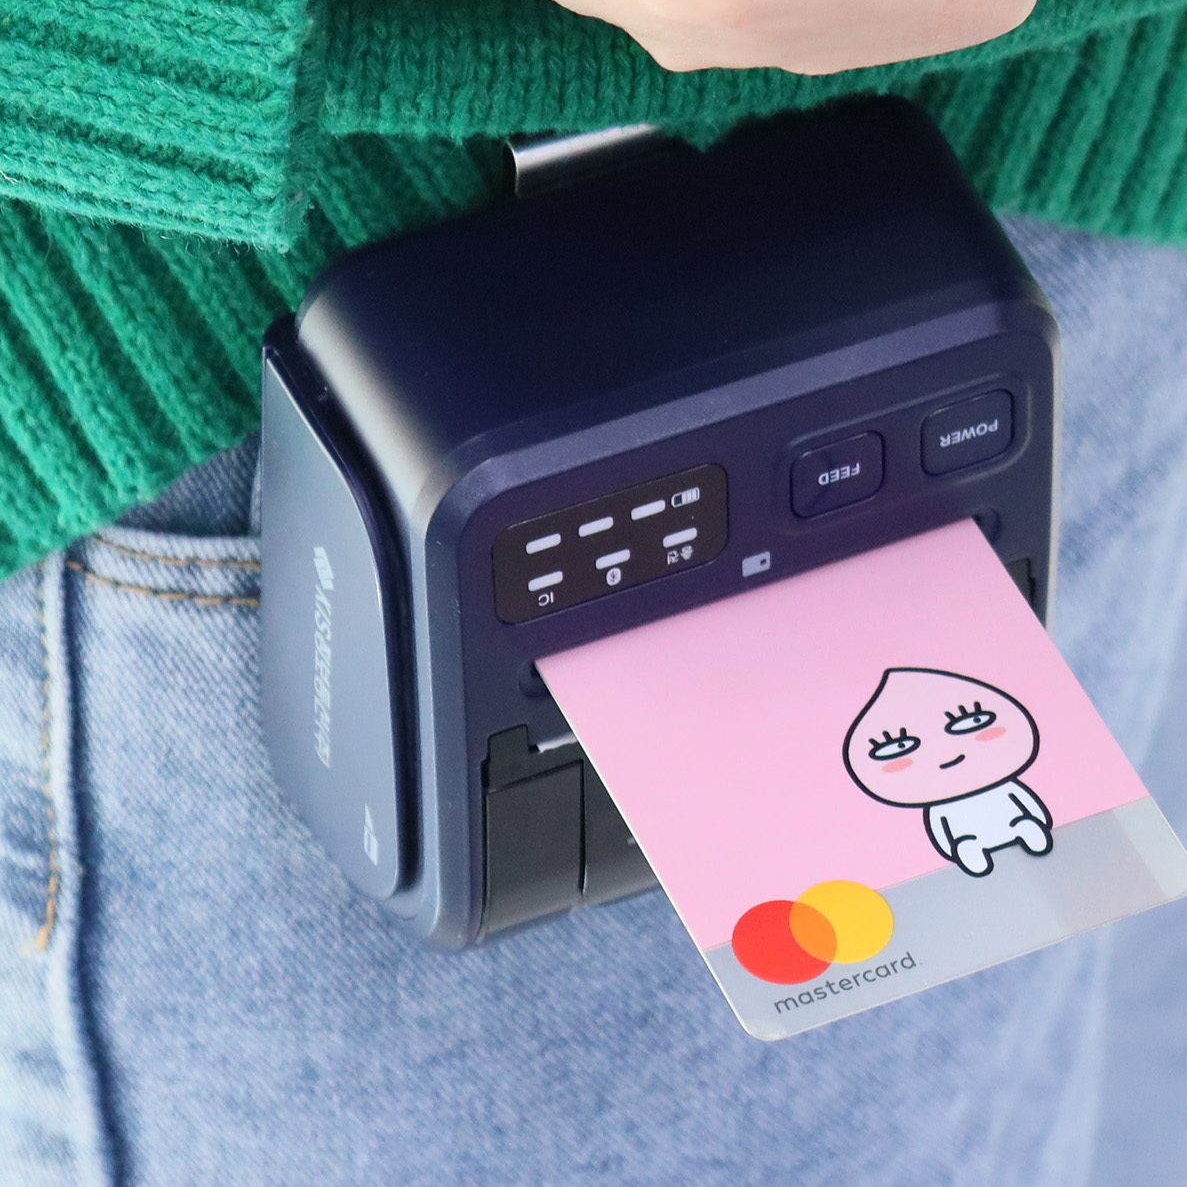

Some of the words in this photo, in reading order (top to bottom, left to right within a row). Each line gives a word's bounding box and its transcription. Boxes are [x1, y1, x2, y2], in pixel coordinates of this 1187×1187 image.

[939, 419, 999, 448] POWER
[818, 463, 861, 486] FEED
[667, 545, 694, 565] 충전
[538, 592, 554, 606] IC
[773, 951, 917, 1014] mastercard
